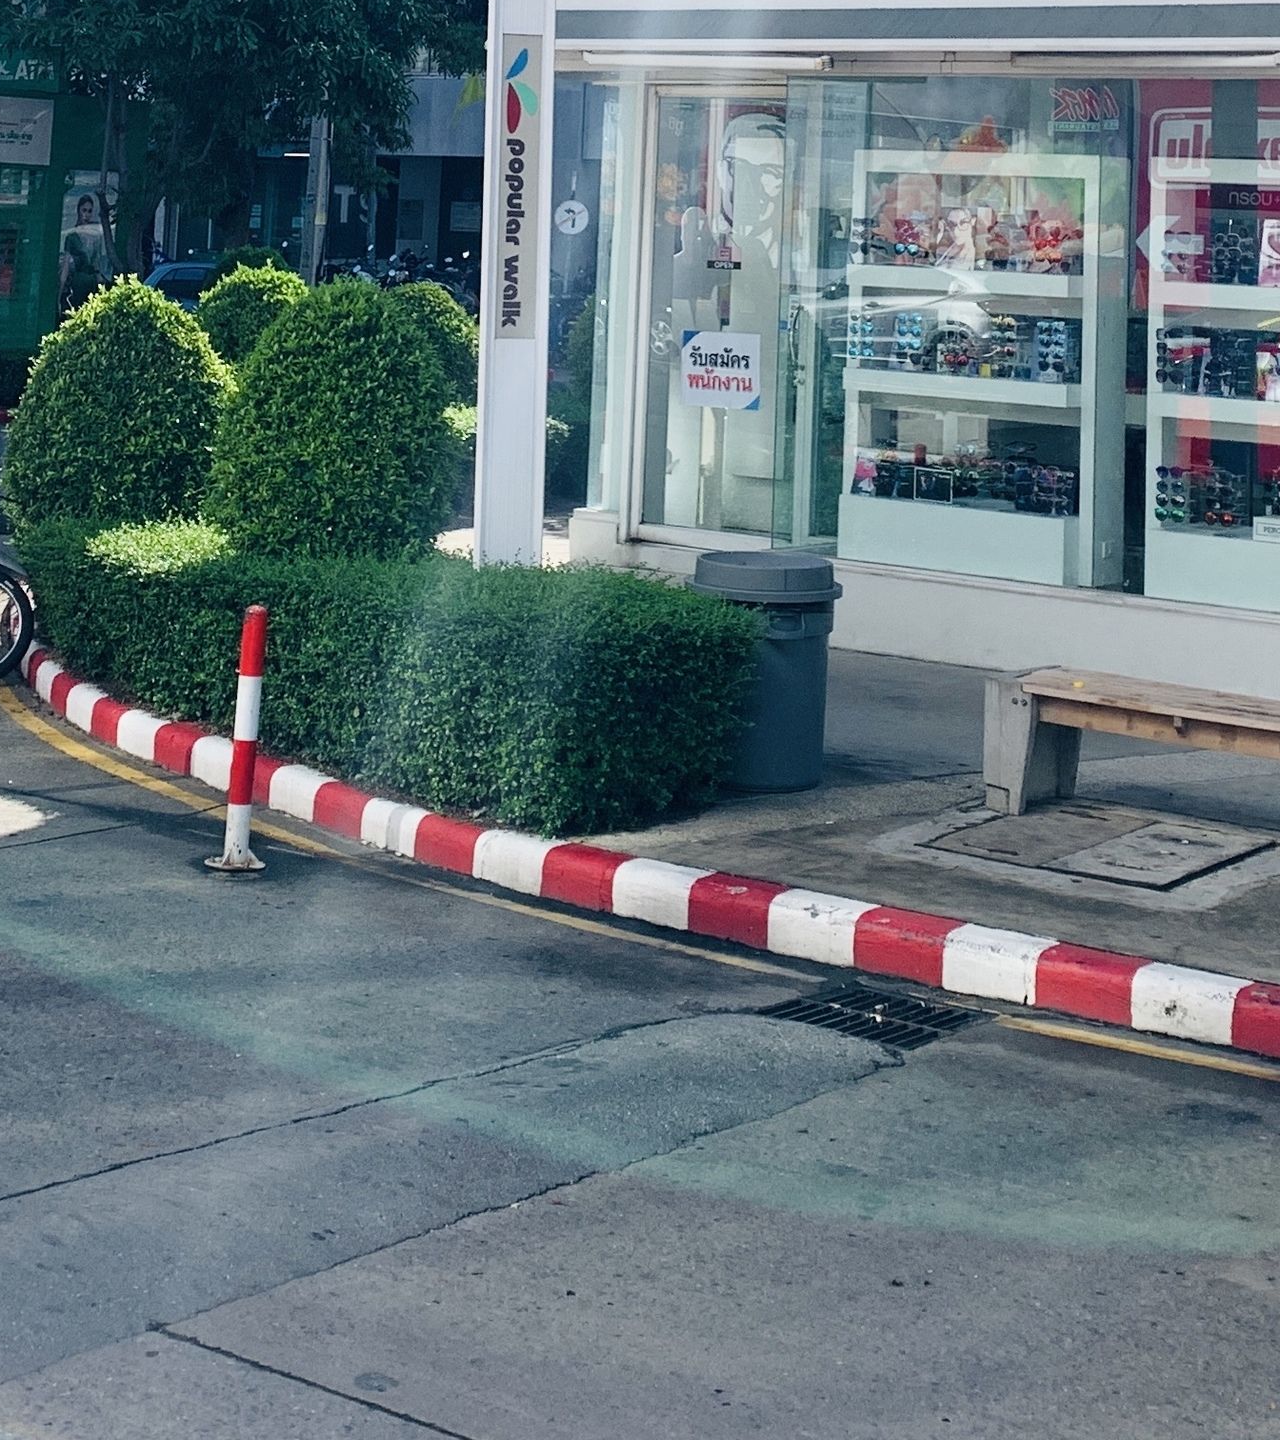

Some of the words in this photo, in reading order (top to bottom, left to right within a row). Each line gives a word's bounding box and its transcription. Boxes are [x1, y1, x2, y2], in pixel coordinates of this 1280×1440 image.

[504, 138, 525, 246] popular
[713, 261, 734, 269] OPEN
[501, 254, 522, 328] walk
[689, 346, 750, 369] รับสมัคร
[687, 368, 753, 393] พนักงาน
